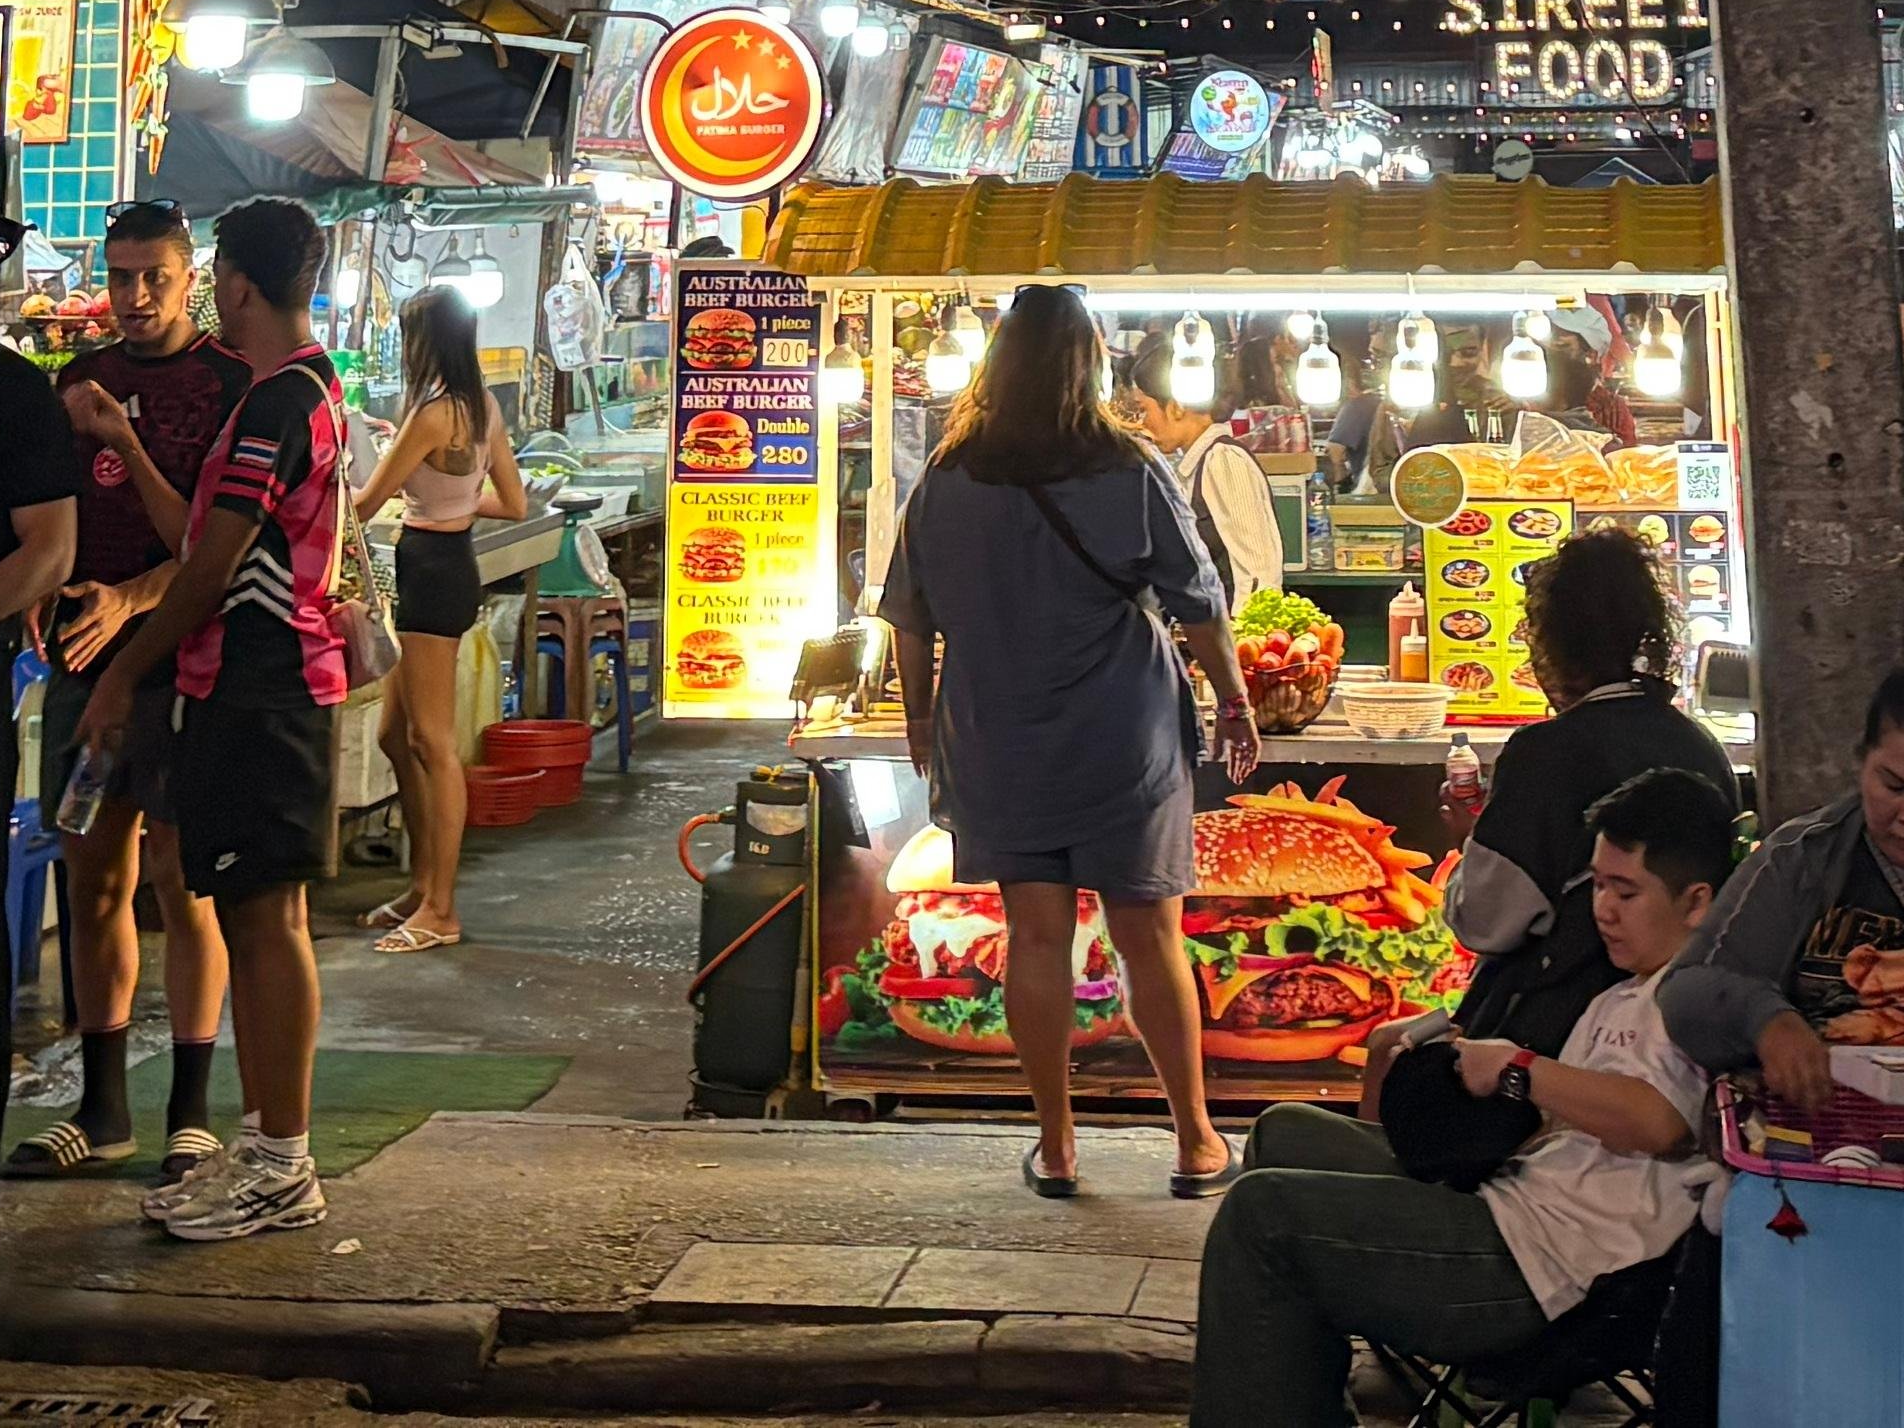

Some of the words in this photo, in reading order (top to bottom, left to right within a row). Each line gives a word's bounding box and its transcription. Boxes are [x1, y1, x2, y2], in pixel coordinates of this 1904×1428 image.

[1495, 39, 1671, 99] FOOD
[691, 65, 791, 122] حلال
[739, 123, 786, 136] BURGER
[687, 275, 809, 291] AUSTRALIAN
[684, 293, 732, 308] BEEF
[735, 293, 816, 308] BURGER
[772, 314, 811, 333] piece
[766, 341, 805, 363] 200
[684, 377, 809, 393] AUSTRALIAN
[681, 394, 730, 409] BEEF
[733, 394, 814, 410] BURGER
[757, 417, 810, 434] Double
[762, 444, 808, 465] 280
[680, 491, 761, 506] CLASSIC
[765, 492, 812, 506] BEEF
[706, 508, 785, 523] BURGER
[766, 532, 805, 549] piece
